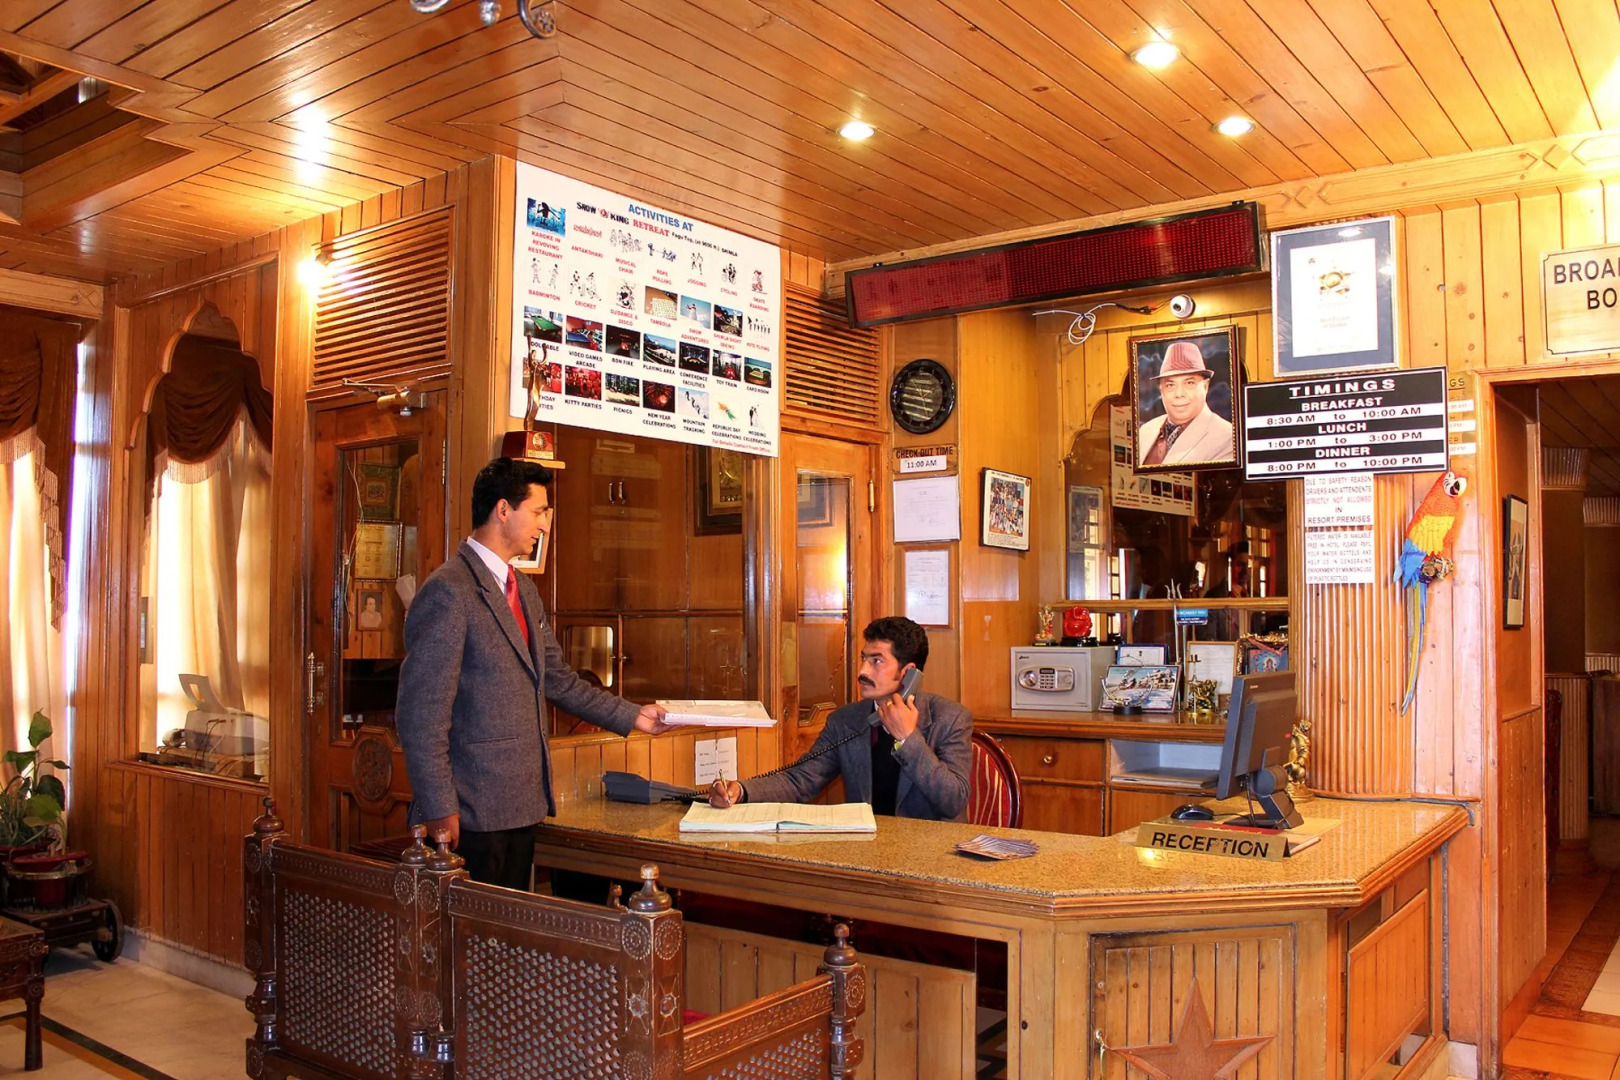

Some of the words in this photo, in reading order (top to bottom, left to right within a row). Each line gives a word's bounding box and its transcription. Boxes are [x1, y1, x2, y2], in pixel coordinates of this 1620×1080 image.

[629, 204, 680, 228] ACTIVITIES
[682, 221, 693, 232] AT
[577, 202, 596, 214] SNOW
[610, 213, 630, 225] KING
[633, 219, 670, 237] RETREAT
[722, 248, 738, 256] SHIMLA
[528, 246, 563, 260] RESTAURANT
[615, 258, 636, 268] MUSICAL
[618, 266, 634, 275] CHAIR
[1554, 257, 1620, 284] BROA
[688, 278, 707, 287] JOGGING
[528, 289, 560, 302] BADMINTON
[720, 287, 738, 296] CYCLING
[575, 300, 596, 310] CRICKET
[750, 303, 770, 312] BOARDING
[650, 318, 672, 328] TAMBOLA
[689, 328, 702, 336] SNOW
[714, 333, 729, 341] SHIMLA
[681, 334, 710, 344] ADVENTURES
[756, 344, 770, 352] FLYING
[568, 350, 584, 359] VIDEO
[585, 354, 603, 362] GAMES
[576, 360, 596, 368] ARCADE
[623, 360, 634, 368] FIRE
[642, 364, 662, 373] PLAYING
[663, 368, 676, 376] AREA
[680, 372, 708, 382] CONFERENCE
[682, 380, 706, 389] FACILITIES
[1289, 379, 1396, 397] TIMINGS
[581, 402, 602, 410] PARTIES
[1301, 397, 1383, 412] BREAKFAST
[614, 406, 633, 414] PICNICS
[1266, 416, 1292, 426] 8:30
[1296, 414, 1316, 422] AM
[1334, 412, 1346, 421] to
[1362, 409, 1396, 418] 10:00
[1400, 407, 1422, 416] AM
[642, 419, 676, 430] CELEBRATIONS
[682, 418, 706, 427] MOUNTAIN
[712, 424, 732, 432] REPUBLIC
[1318, 422, 1367, 434] LUNCH
[712, 431, 742, 441] CELEBRATIONS
[748, 430, 766, 438] WEDDING
[743, 436, 772, 446] CELEBRATIONS
[1268, 440, 1292, 448] 1:00
[1297, 438, 1316, 447] PM
[1335, 436, 1347, 444] to
[1369, 434, 1397, 442] 3:00
[1402, 432, 1422, 440] PM
[896, 449, 918, 459] CHECK
[920, 448, 934, 456] OUT
[936, 446, 953, 456] TIME
[1315, 446, 1370, 458] DINNER
[907, 460, 924, 468] 11:00
[1267, 463, 1293, 472] 8:00
[1297, 462, 1316, 470] PM
[1335, 460, 1347, 468] to
[1363, 458, 1398, 467] 10:00
[1402, 456, 1422, 464] PM
[1306, 478, 1316, 486] DUE
[1328, 476, 1347, 484] SAFETY
[1306, 496, 1329, 504] STRICTLY
[1333, 496, 1343, 504] NOT
[1308, 516, 1334, 524] RESORT
[1151, 832, 1269, 858] RECEPTION
